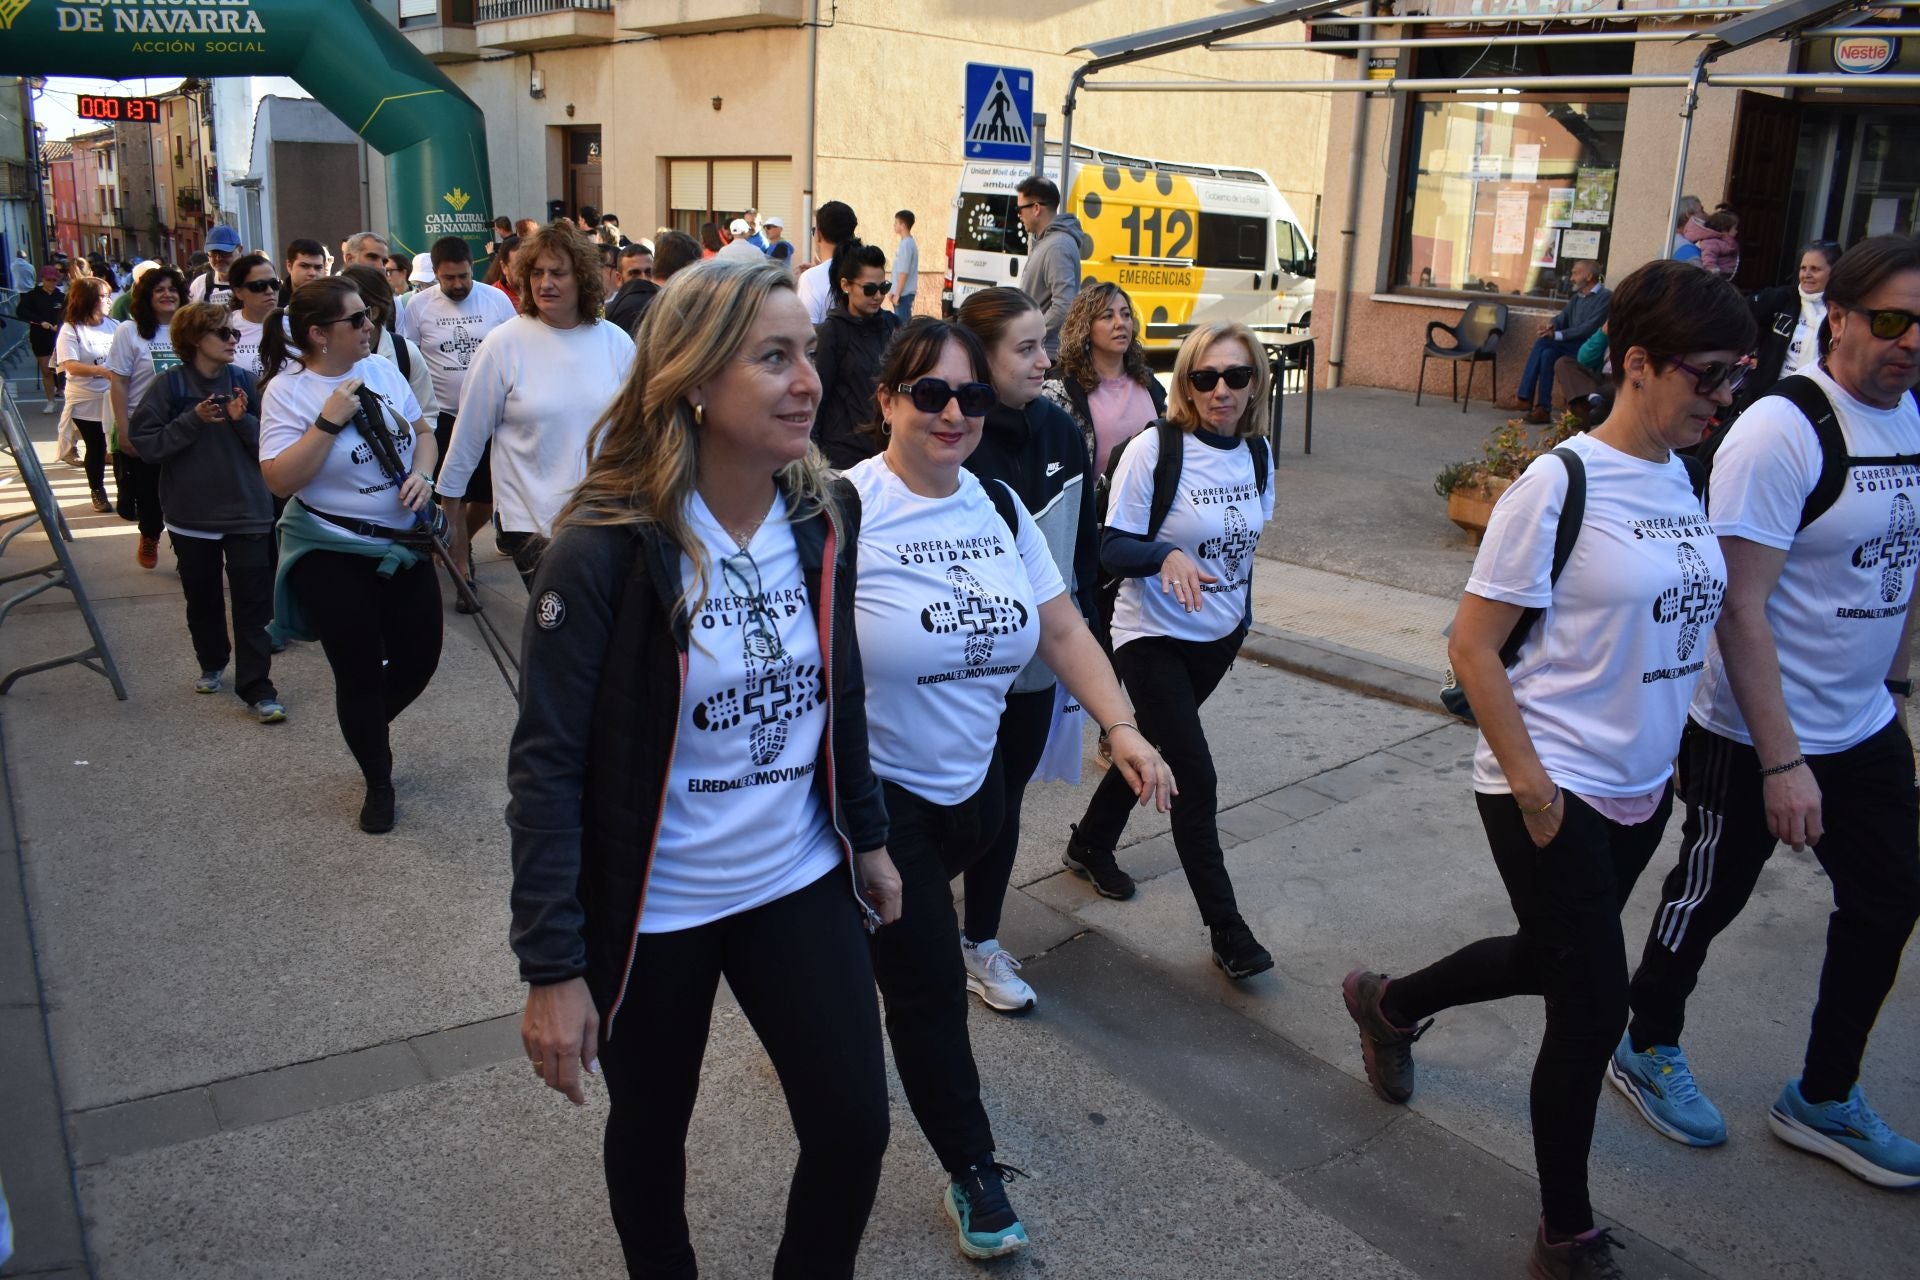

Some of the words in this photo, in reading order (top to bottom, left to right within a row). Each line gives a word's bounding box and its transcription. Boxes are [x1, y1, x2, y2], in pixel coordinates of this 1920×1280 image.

[56, 7, 104, 32] DE
[113, 9, 266, 34] NAVARRA
[131, 39, 196, 53] ACCIÓN
[205, 41, 265, 53] SOCIAL
[1840, 45, 1889, 60] Nestlé
[970, 167, 992, 175] Unidad
[992, 168, 1009, 177] Móvil
[426, 213, 454, 225] CAJA
[454, 213, 486, 223] RURAL
[978, 214, 995, 227] 112
[424, 224, 443, 234] DE
[1121, 205, 1194, 267] 112
[1119, 269, 1192, 286] EMERGENCIAS
[1853, 467, 1920, 481] CARRERA-MAR
[1634, 525, 1716, 540] SOLIDARIA
[896, 535, 1001, 555] CARRERA-MARCHA
[900, 545, 1005, 565] SOLIDARIA
[917, 664, 1021, 685] ELREDALENMOVIMIENTO
[688, 763, 815, 793] ELREDALENMOVIMIEN
